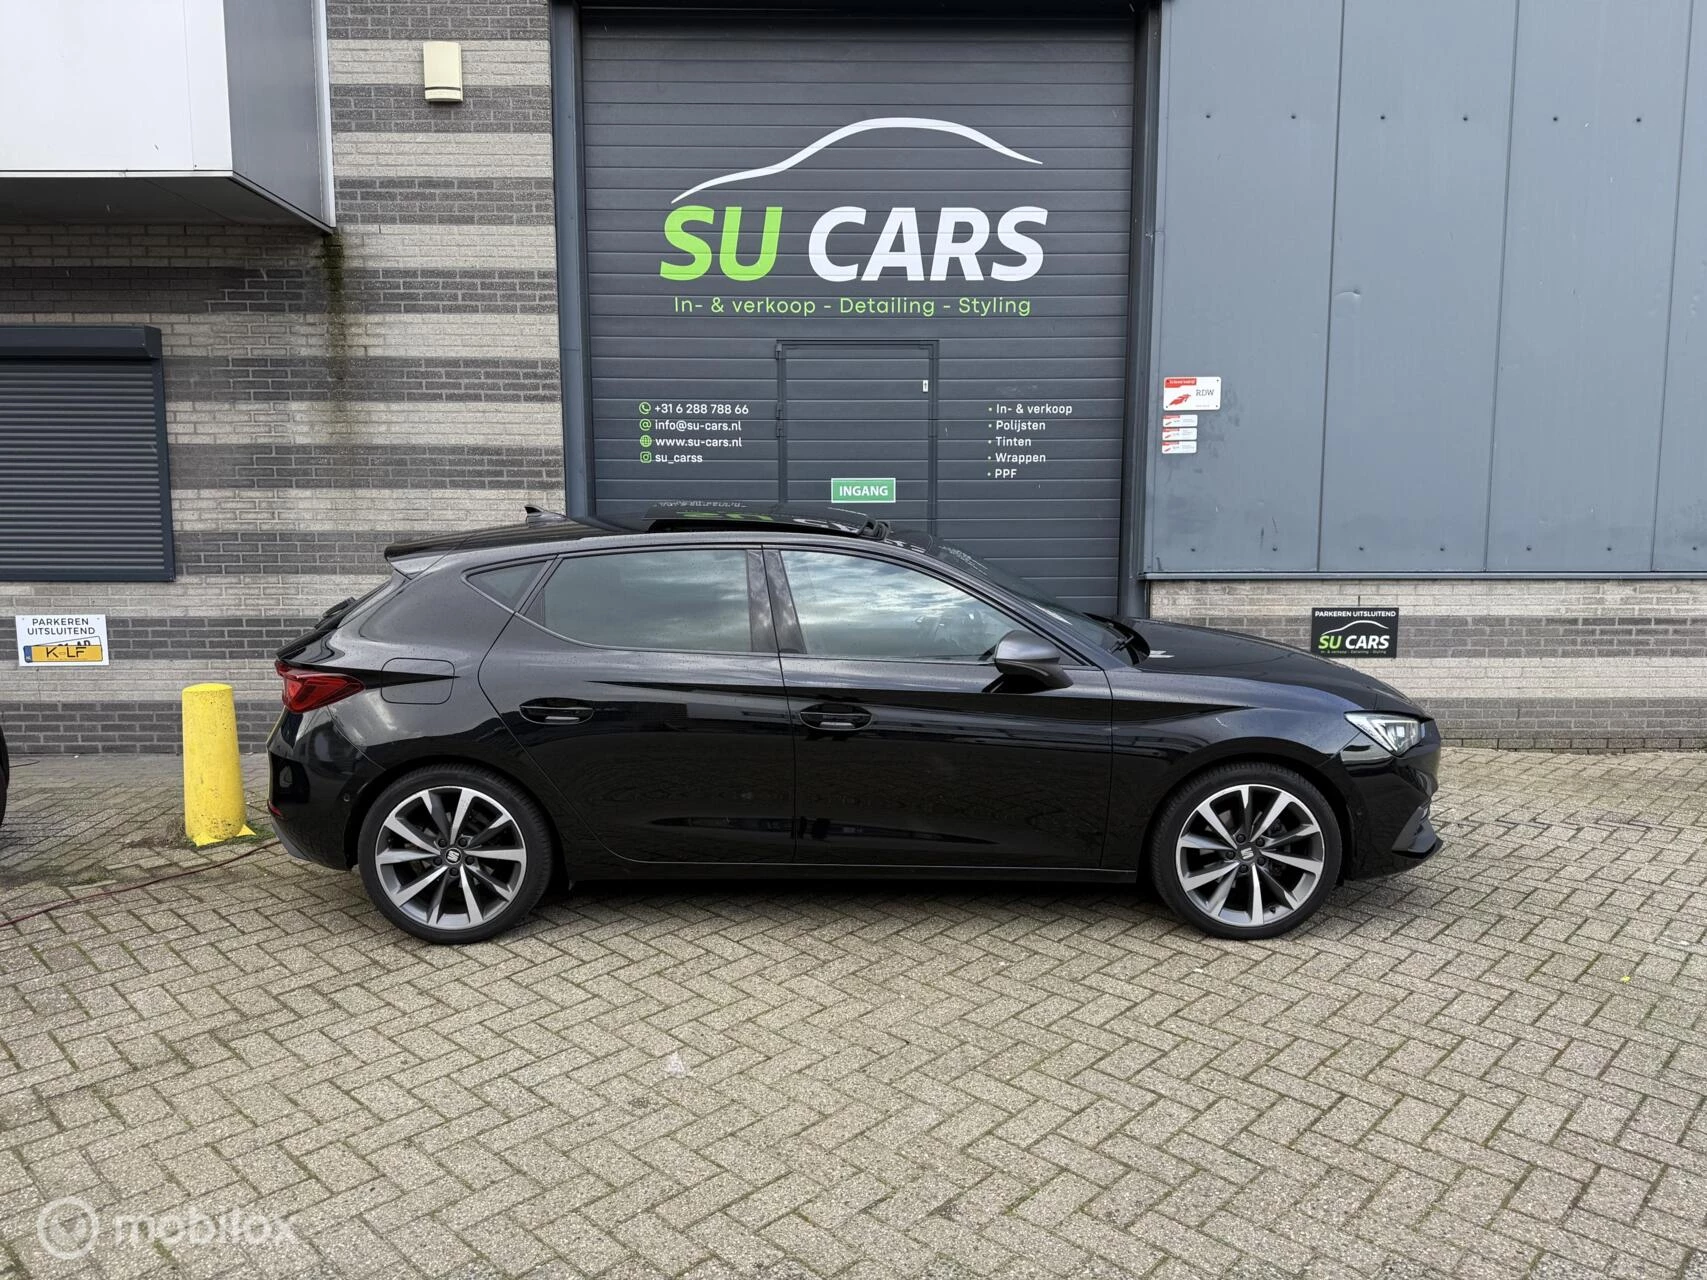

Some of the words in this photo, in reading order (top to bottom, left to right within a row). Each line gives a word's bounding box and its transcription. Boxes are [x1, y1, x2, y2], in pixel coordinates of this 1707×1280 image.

[659, 205, 783, 282] SU
[808, 205, 1049, 282] CARS
[674, 296, 703, 313] In-
[711, 297, 725, 314] &
[732, 296, 816, 317] verkoop
[840, 296, 935, 317] Detailing
[958, 296, 1031, 318] Styling
[654, 403, 673, 415] +31
[675, 403, 684, 414] 6
[685, 403, 708, 415] 288
[710, 403, 732, 416] 788
[734, 404, 749, 416] 66
[996, 403, 1012, 414] In-
[1015, 403, 1024, 414] &
[1026, 403, 1073, 415] verkoop
[654, 419, 742, 432] info@su-cars.nl
[995, 419, 1046, 433] Polijsten
[655, 436, 743, 448] www.su-cars.nl
[995, 436, 1032, 447] Tinten
[654, 453, 704, 465] su_carss
[995, 452, 1047, 465] Wrappen
[994, 468, 1017, 479] PPF
[839, 485, 889, 497] INGANG
[32, 618, 89, 626] PARKEREN
[27, 627, 96, 635] UITSLUITEND
[1318, 635, 1342, 649] SU
[1345, 635, 1390, 650] CARS
